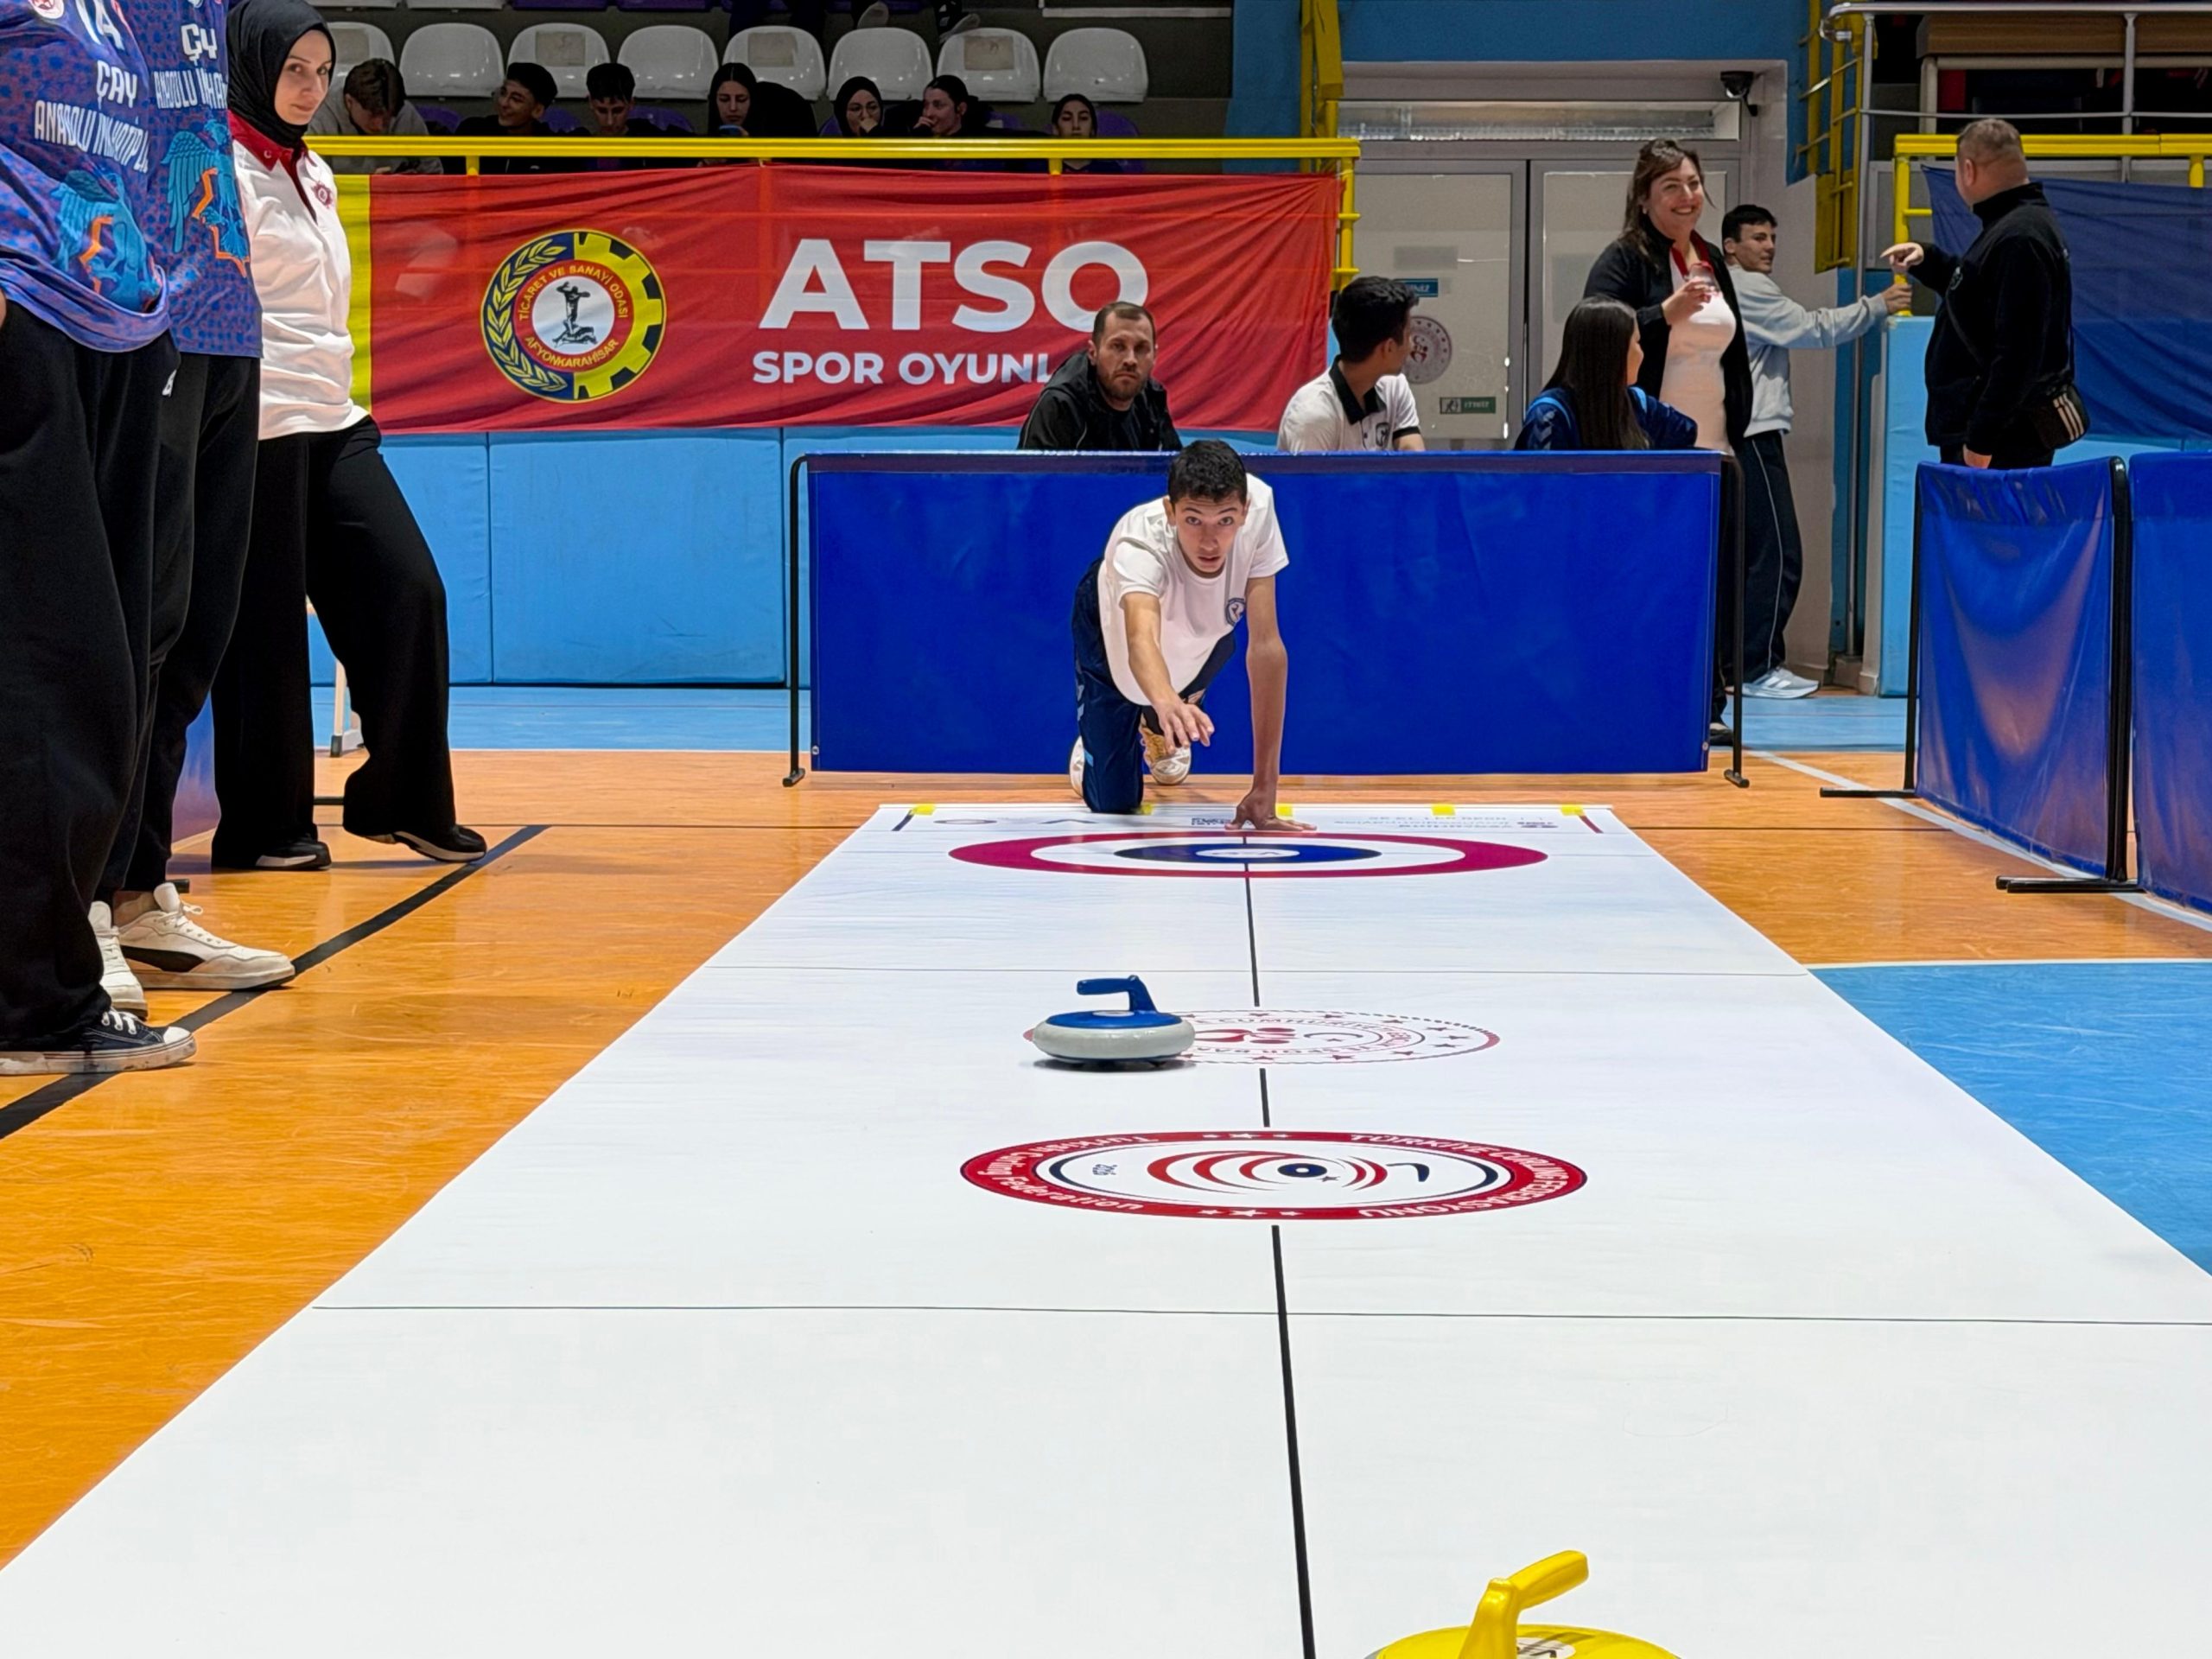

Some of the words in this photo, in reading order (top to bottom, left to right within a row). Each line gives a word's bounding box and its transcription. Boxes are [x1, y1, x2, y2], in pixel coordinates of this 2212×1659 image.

[95, 60, 138, 108] ÇAY
[35, 100, 97, 152] ANADOLU
[518, 276, 549, 321] TİCARET
[549, 267, 565, 278] VE
[569, 265, 614, 285] SANAYİ
[609, 283, 628, 318] ODASI
[759, 238, 1148, 333] ATSO
[753, 352, 883, 384] SPOR
[991, 1176, 1144, 1211] Federation
